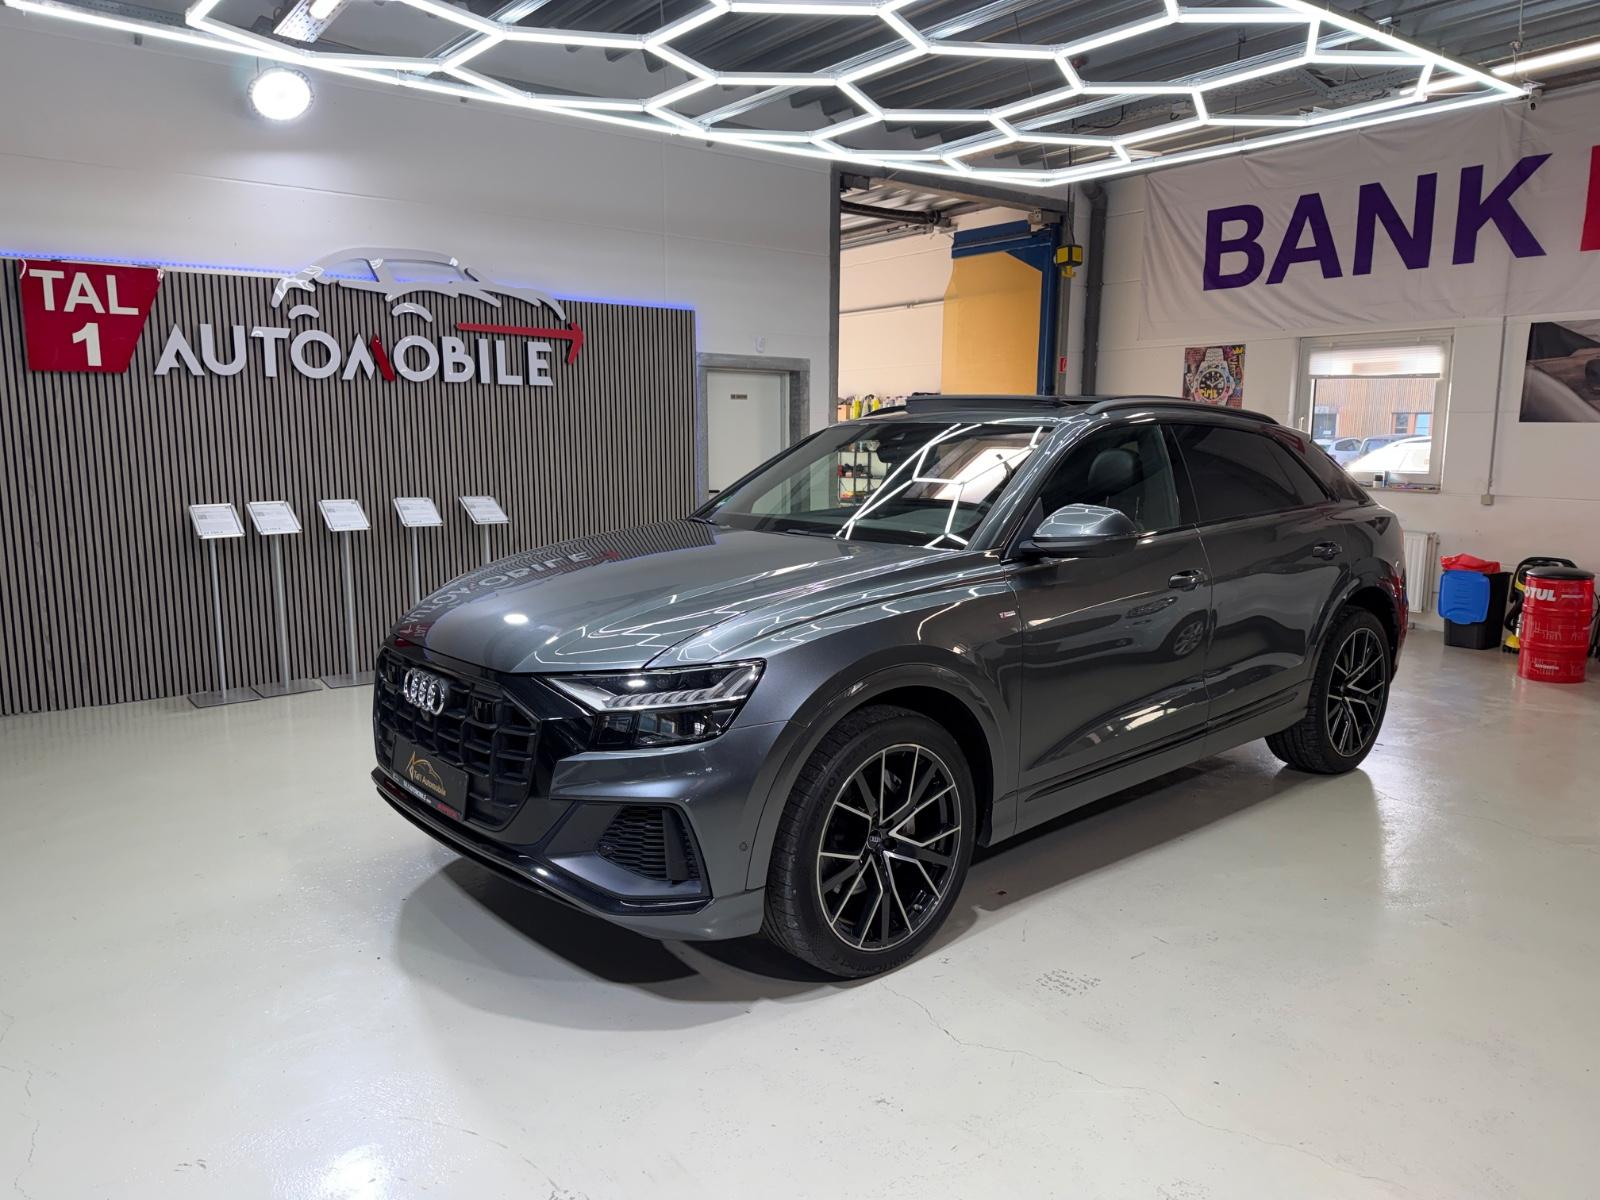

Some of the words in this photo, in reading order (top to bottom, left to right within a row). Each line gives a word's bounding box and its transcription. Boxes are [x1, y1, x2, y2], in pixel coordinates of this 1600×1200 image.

[1203, 153, 1553, 291] BANK
[28, 268, 139, 316] TAL
[71, 322, 103, 367] 1
[154, 322, 554, 387] AUTOMOBILE
[1524, 586, 1557, 602] OTUL
